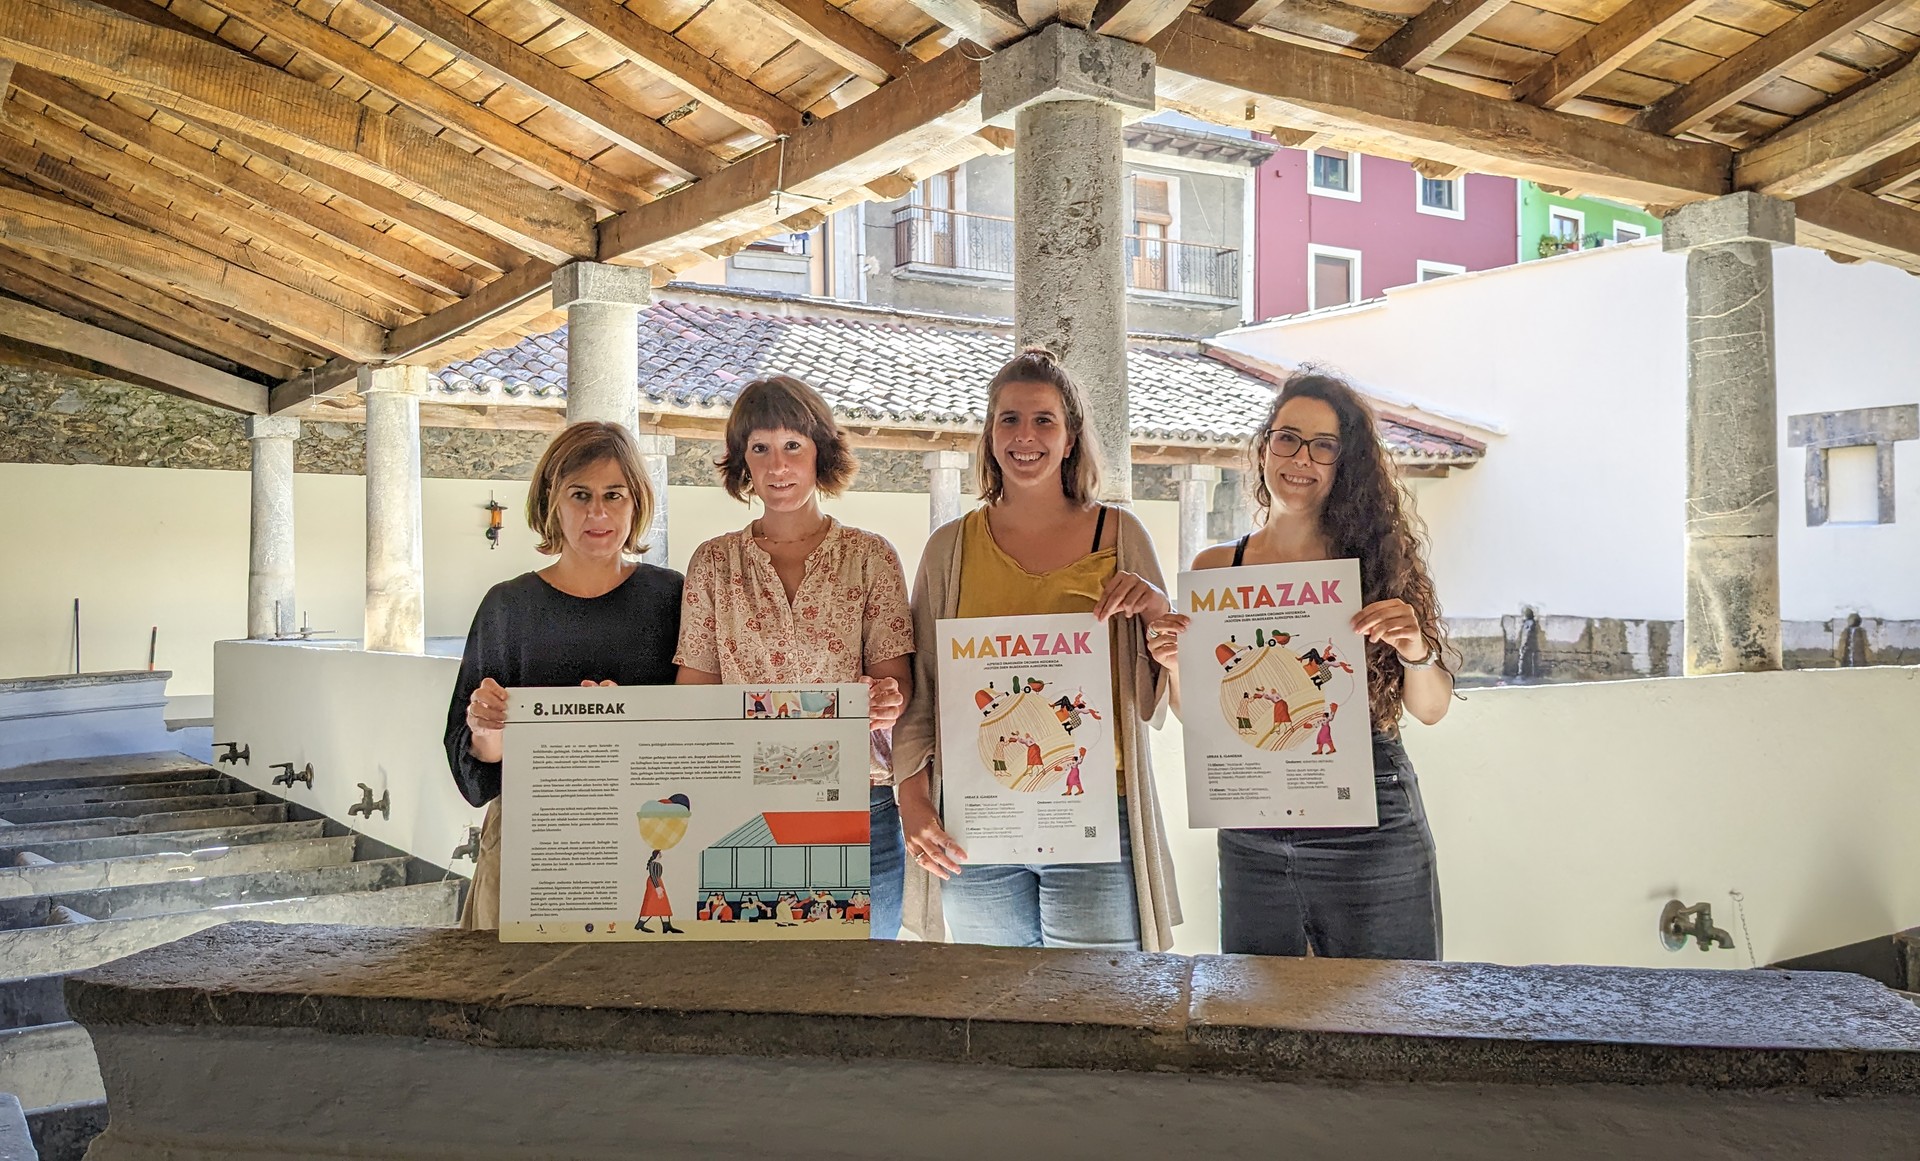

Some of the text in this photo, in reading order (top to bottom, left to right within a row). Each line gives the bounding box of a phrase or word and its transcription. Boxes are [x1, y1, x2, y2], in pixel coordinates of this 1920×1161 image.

[1191, 580, 1342, 613] MATAZAK
[952, 632, 1092, 660] MATAZAK
[533, 702, 626, 716] 8. LIXIBERAK
